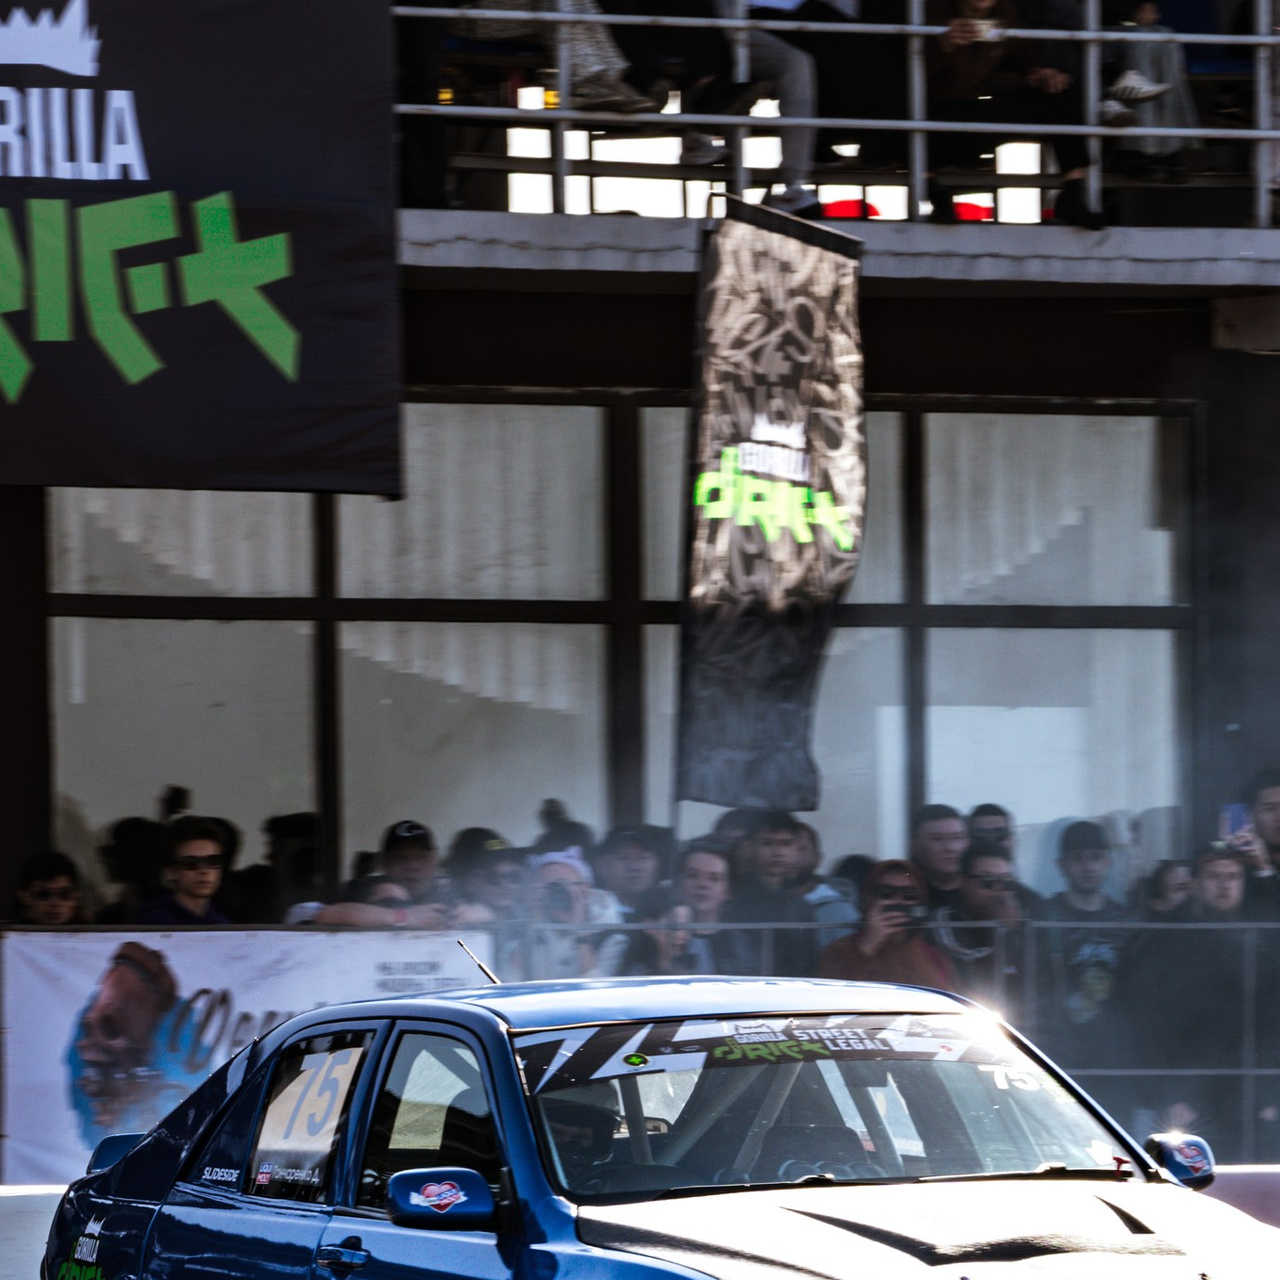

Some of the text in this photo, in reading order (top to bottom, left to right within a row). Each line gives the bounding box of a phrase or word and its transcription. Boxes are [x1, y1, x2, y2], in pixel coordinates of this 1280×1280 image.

[732, 1031, 789, 1044] GORILLA
[792, 1028, 868, 1041] STREET
[823, 1039, 891, 1050] LEGAL
[977, 1065, 1042, 1091] 75
[282, 1048, 352, 1140] 75
[75, 1236, 99, 1263] GORILLA
